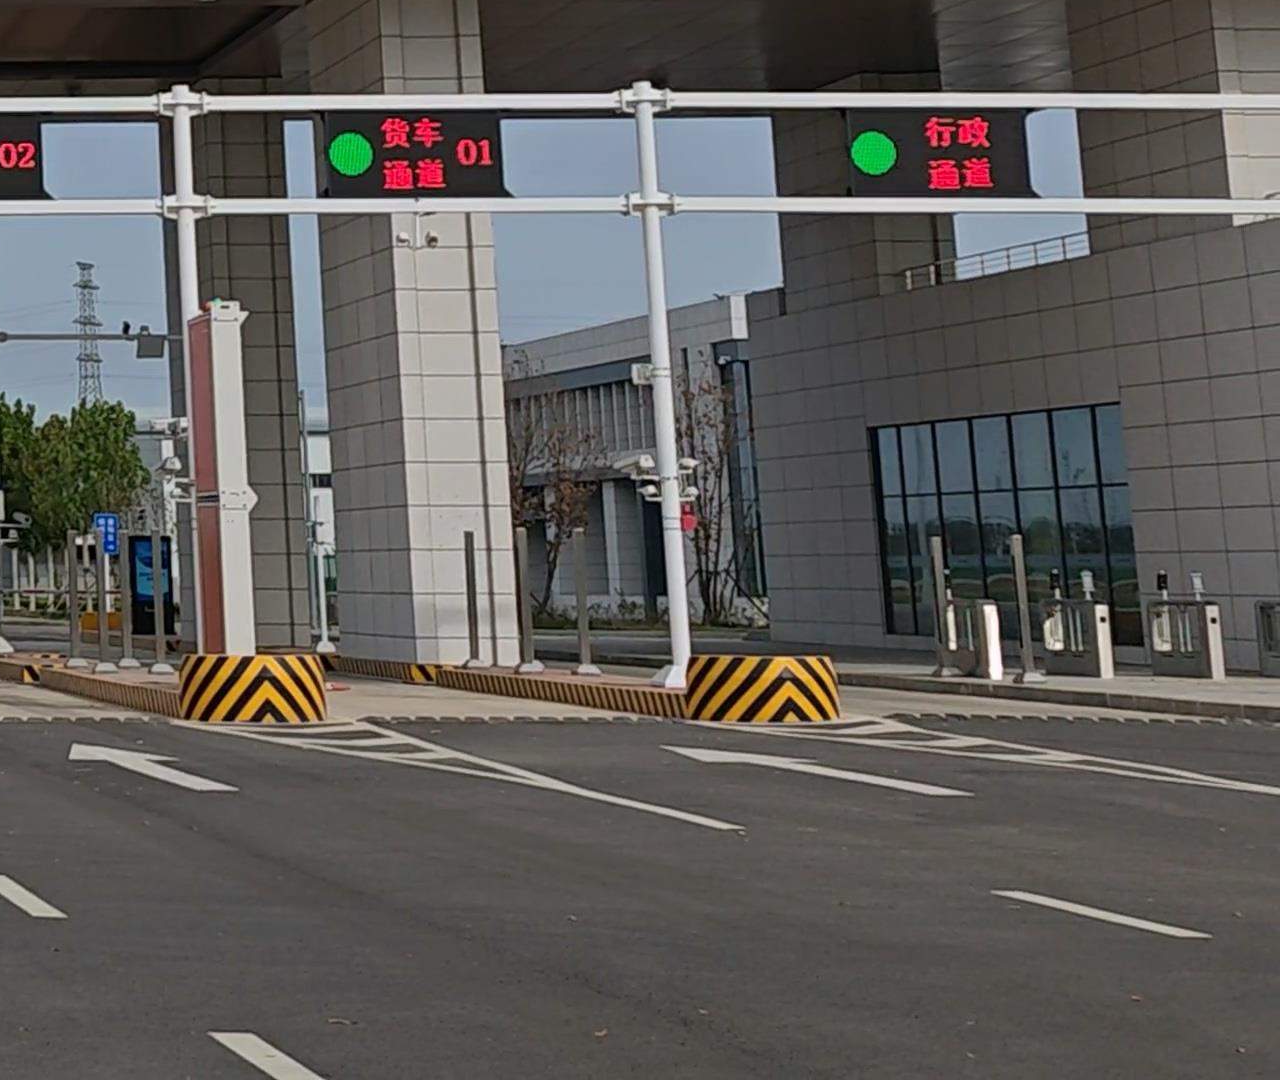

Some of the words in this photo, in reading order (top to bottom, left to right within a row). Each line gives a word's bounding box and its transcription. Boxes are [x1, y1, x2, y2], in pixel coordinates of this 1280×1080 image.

[380, 118, 444, 148] 货车
[925, 116, 991, 148] 行政
[456, 138, 493, 166] 01
[383, 159, 447, 190] 通道
[928, 158, 994, 190] 通道
